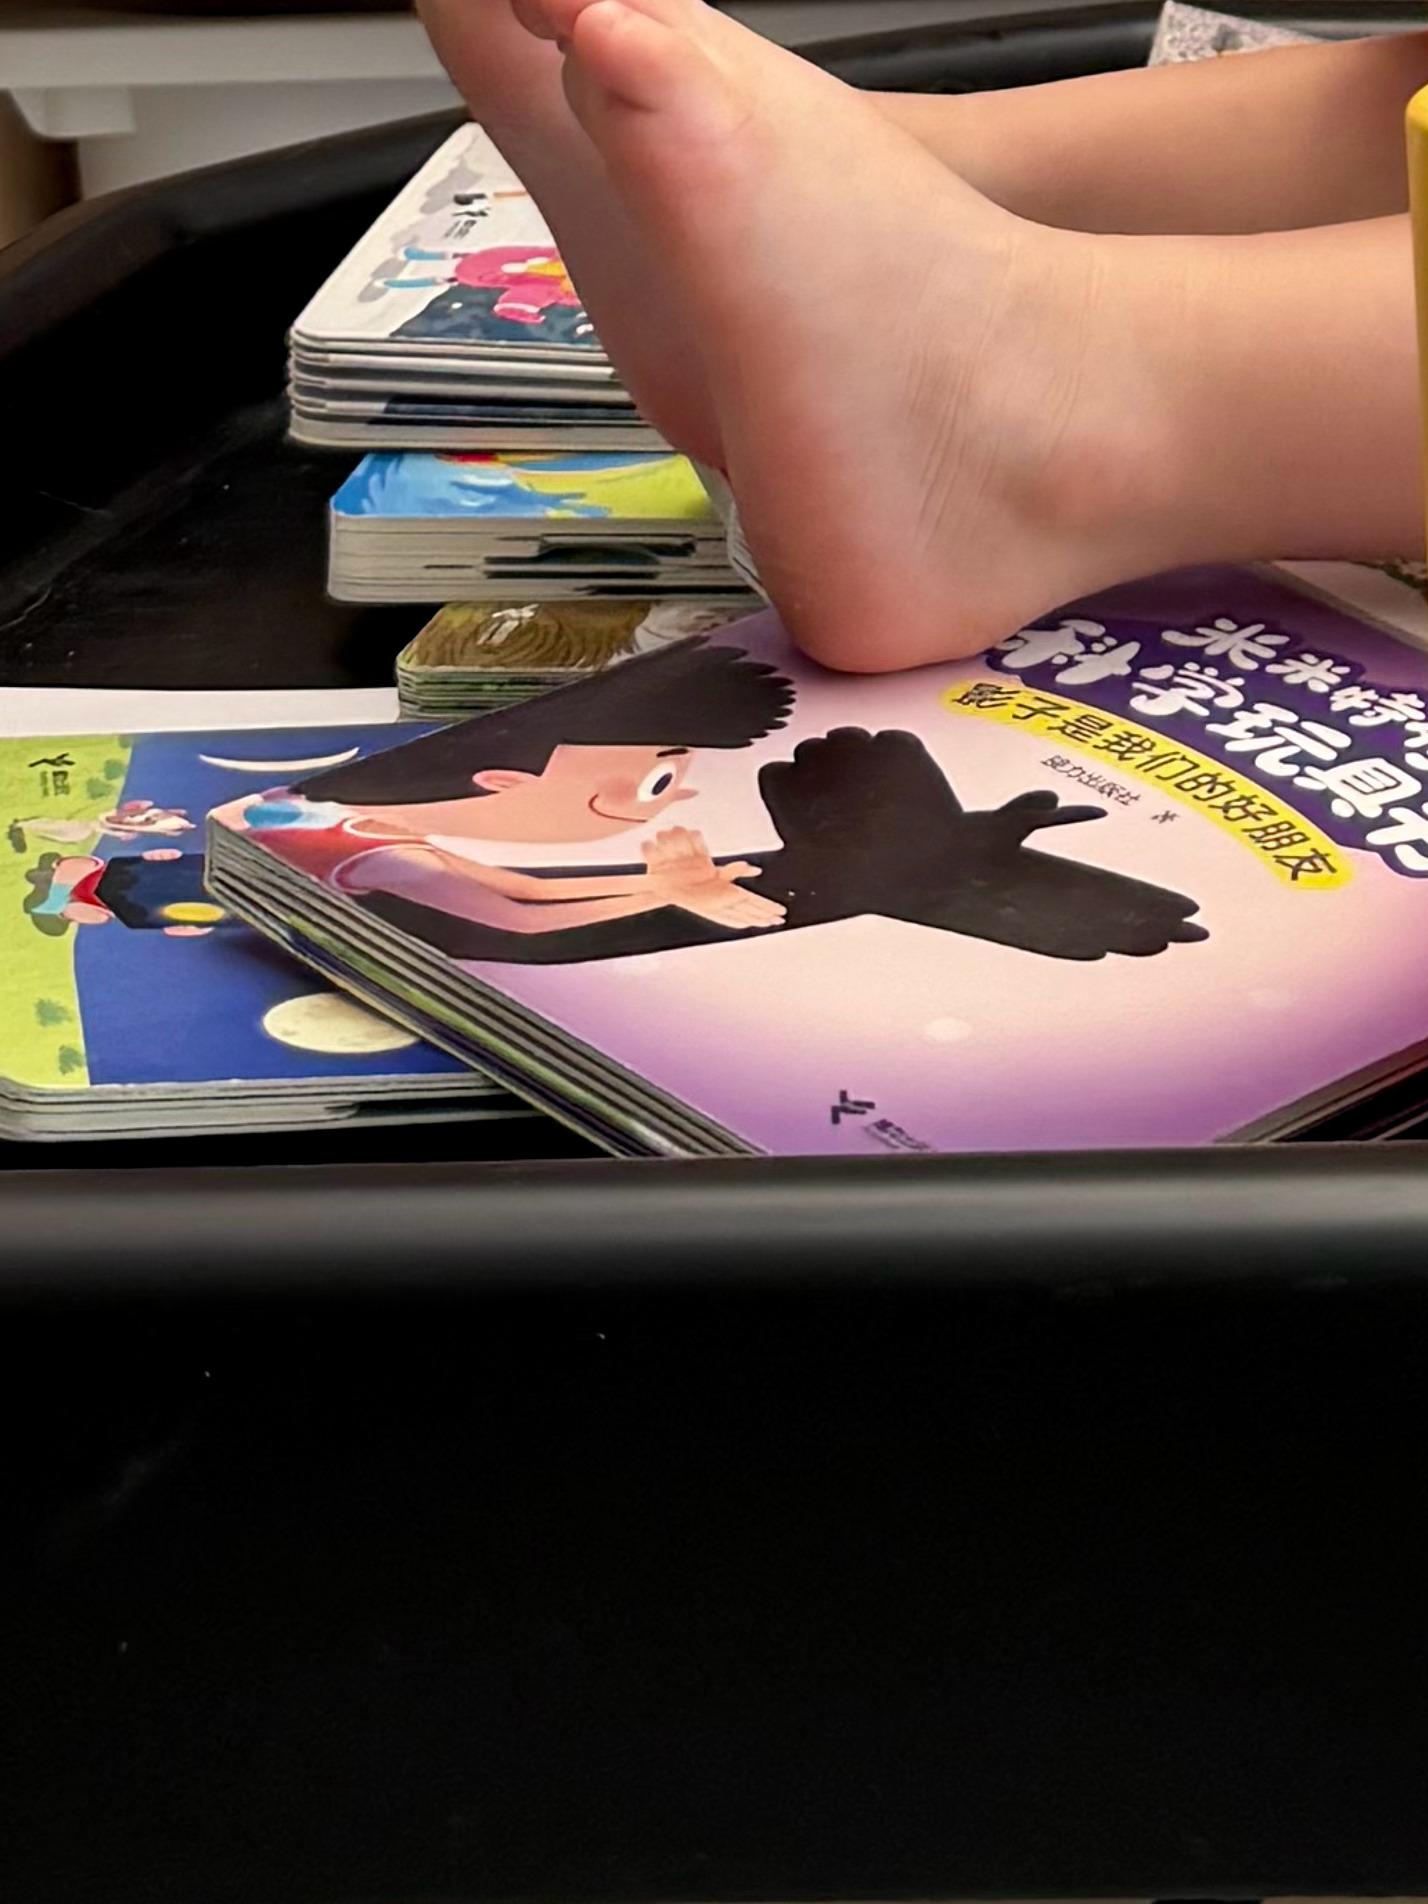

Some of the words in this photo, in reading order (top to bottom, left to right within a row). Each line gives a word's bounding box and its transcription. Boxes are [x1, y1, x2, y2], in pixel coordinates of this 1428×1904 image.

[956, 681, 1338, 882] 影子是我们的好朋友
